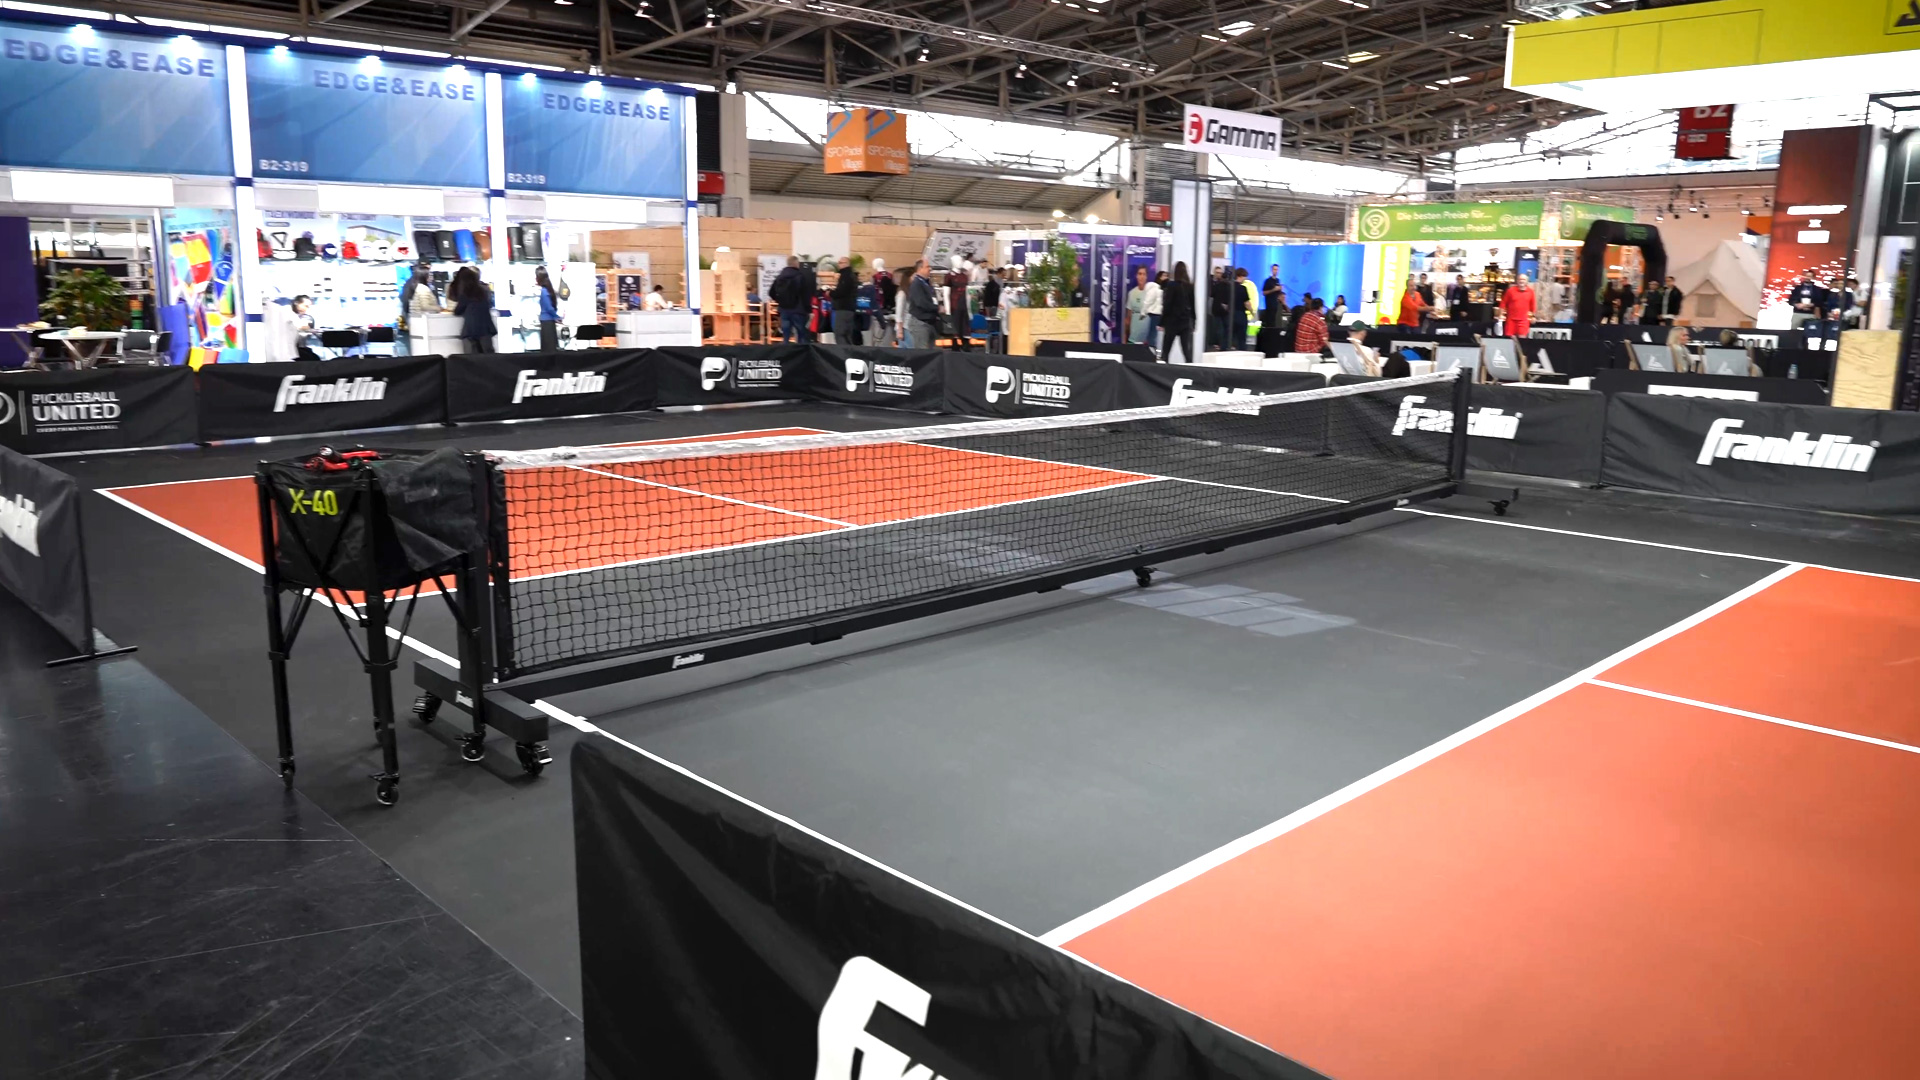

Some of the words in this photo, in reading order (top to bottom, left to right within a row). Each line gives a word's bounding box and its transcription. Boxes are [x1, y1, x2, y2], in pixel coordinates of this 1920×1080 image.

[3, 38, 215, 77] EDGE&EASE
[313, 69, 475, 101] EDGE&EASE
[543, 93, 670, 121] EDGE&EASE
[1205, 118, 1277, 151] GAMMA
[259, 159, 309, 172] B2-319
[507, 172, 546, 184] B2-319
[1396, 212, 1412, 221] Die
[1413, 212, 1441, 220] besten
[1443, 211, 1469, 219] Preise
[1420, 224, 1434, 233] die
[1436, 224, 1465, 233] besten
[738, 360, 782, 368] PICKLEBALL
[874, 364, 914, 374] PICKLEBALL
[737, 368, 783, 380] UNITED
[874, 374, 914, 387] UNITED
[1022, 372, 1071, 386] PICKLEBALL
[1022, 382, 1071, 399] UNITED
[32, 391, 120, 404] PICKLEBALL
[32, 403, 121, 421] UNITED
[288, 488, 339, 516] X-40
